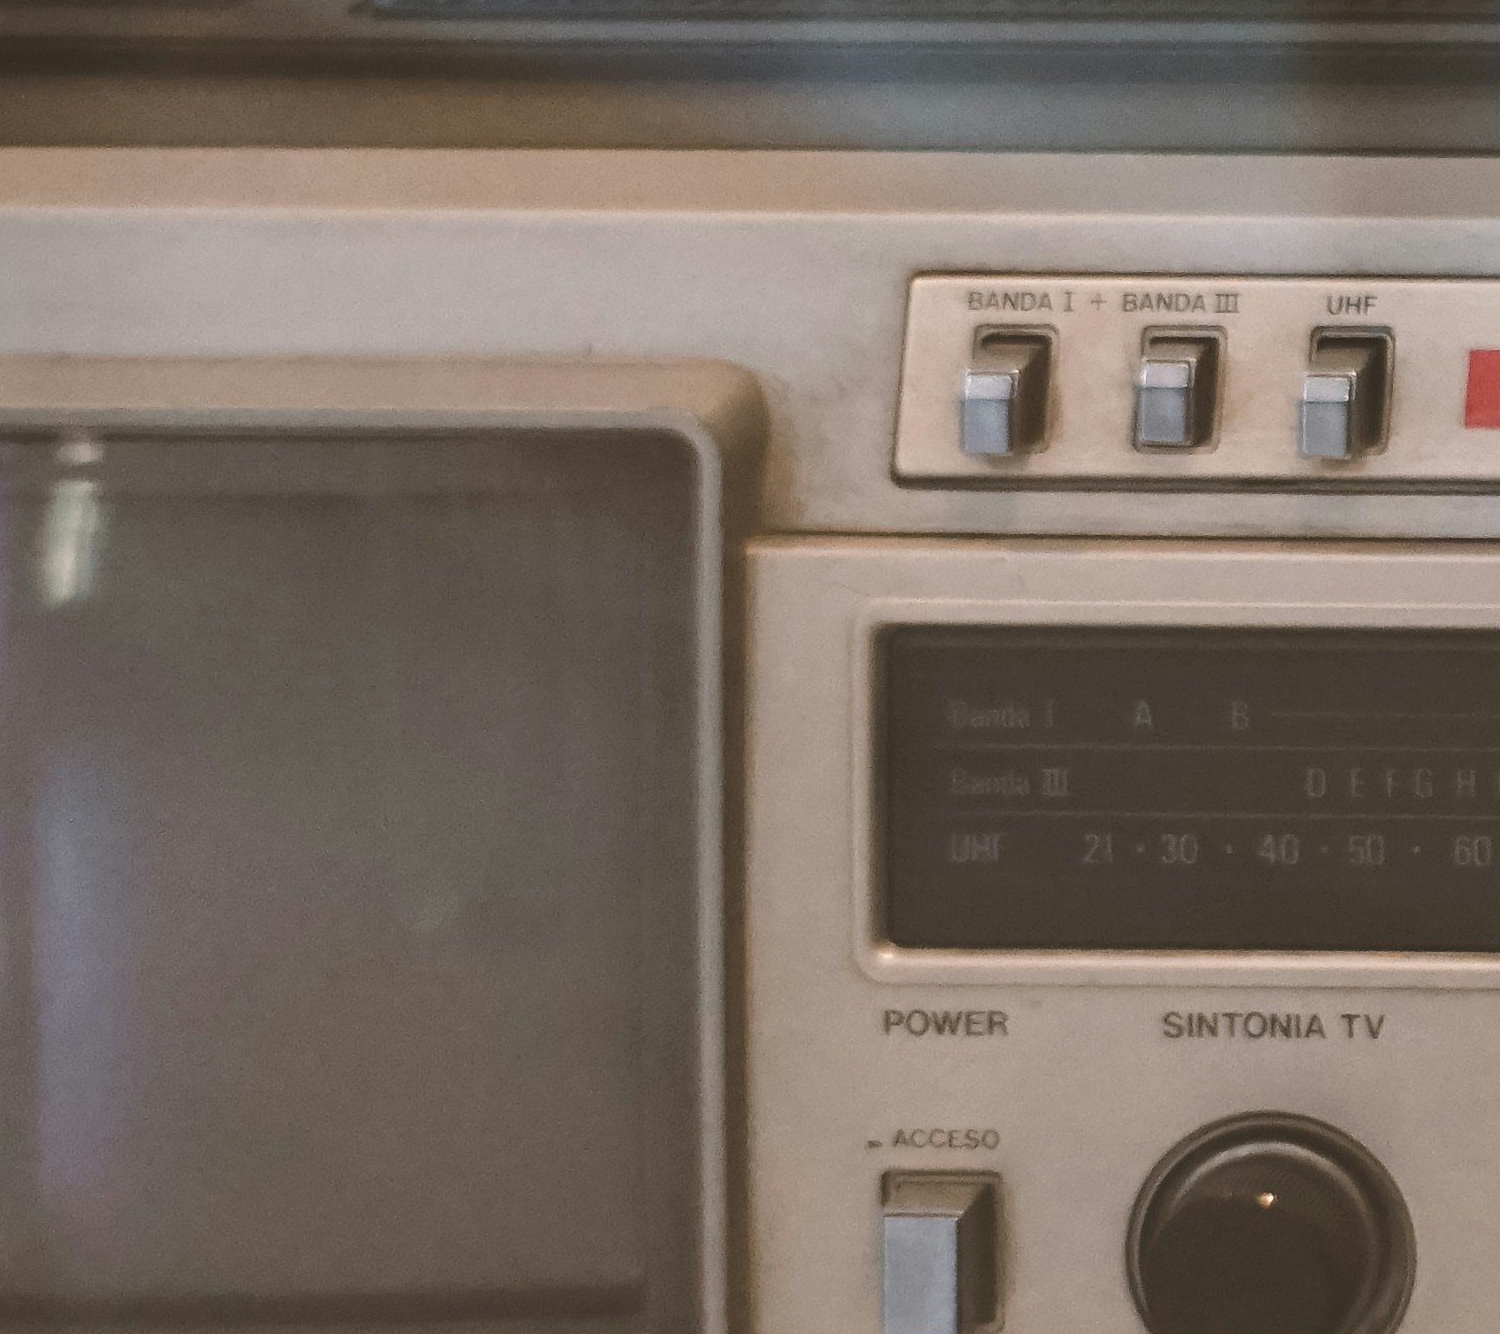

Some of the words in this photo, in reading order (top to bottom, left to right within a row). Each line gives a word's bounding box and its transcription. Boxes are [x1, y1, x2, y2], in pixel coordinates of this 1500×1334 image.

[967, 291, 1053, 313] BANDA
[1122, 293, 1206, 314] BANDA
[1214, 293, 1242, 314] III
[1326, 295, 1377, 316] UHF
[949, 699, 1030, 728] Banda
[1133, 700, 1154, 730] A
[1231, 700, 1250, 731] B
[950, 768, 1030, 796] Banda
[1041, 767, 1070, 797] III
[1305, 768, 1327, 799] D
[1350, 768, 1365, 799] E
[1413, 768, 1433, 799] G
[1456, 769, 1476, 799] H
[950, 832, 1006, 863] UHF
[1082, 833, 1114, 864] 21
[1159, 833, 1198, 865] 30
[1257, 833, 1300, 865] 40
[1349, 834, 1385, 866] 50
[1454, 834, 1493, 867] 60
[883, 1010, 1009, 1038] POWER
[1162, 1012, 1326, 1041] SINTONIA
[1341, 1013, 1386, 1039] TV
[893, 1128, 999, 1149] ACCESO
